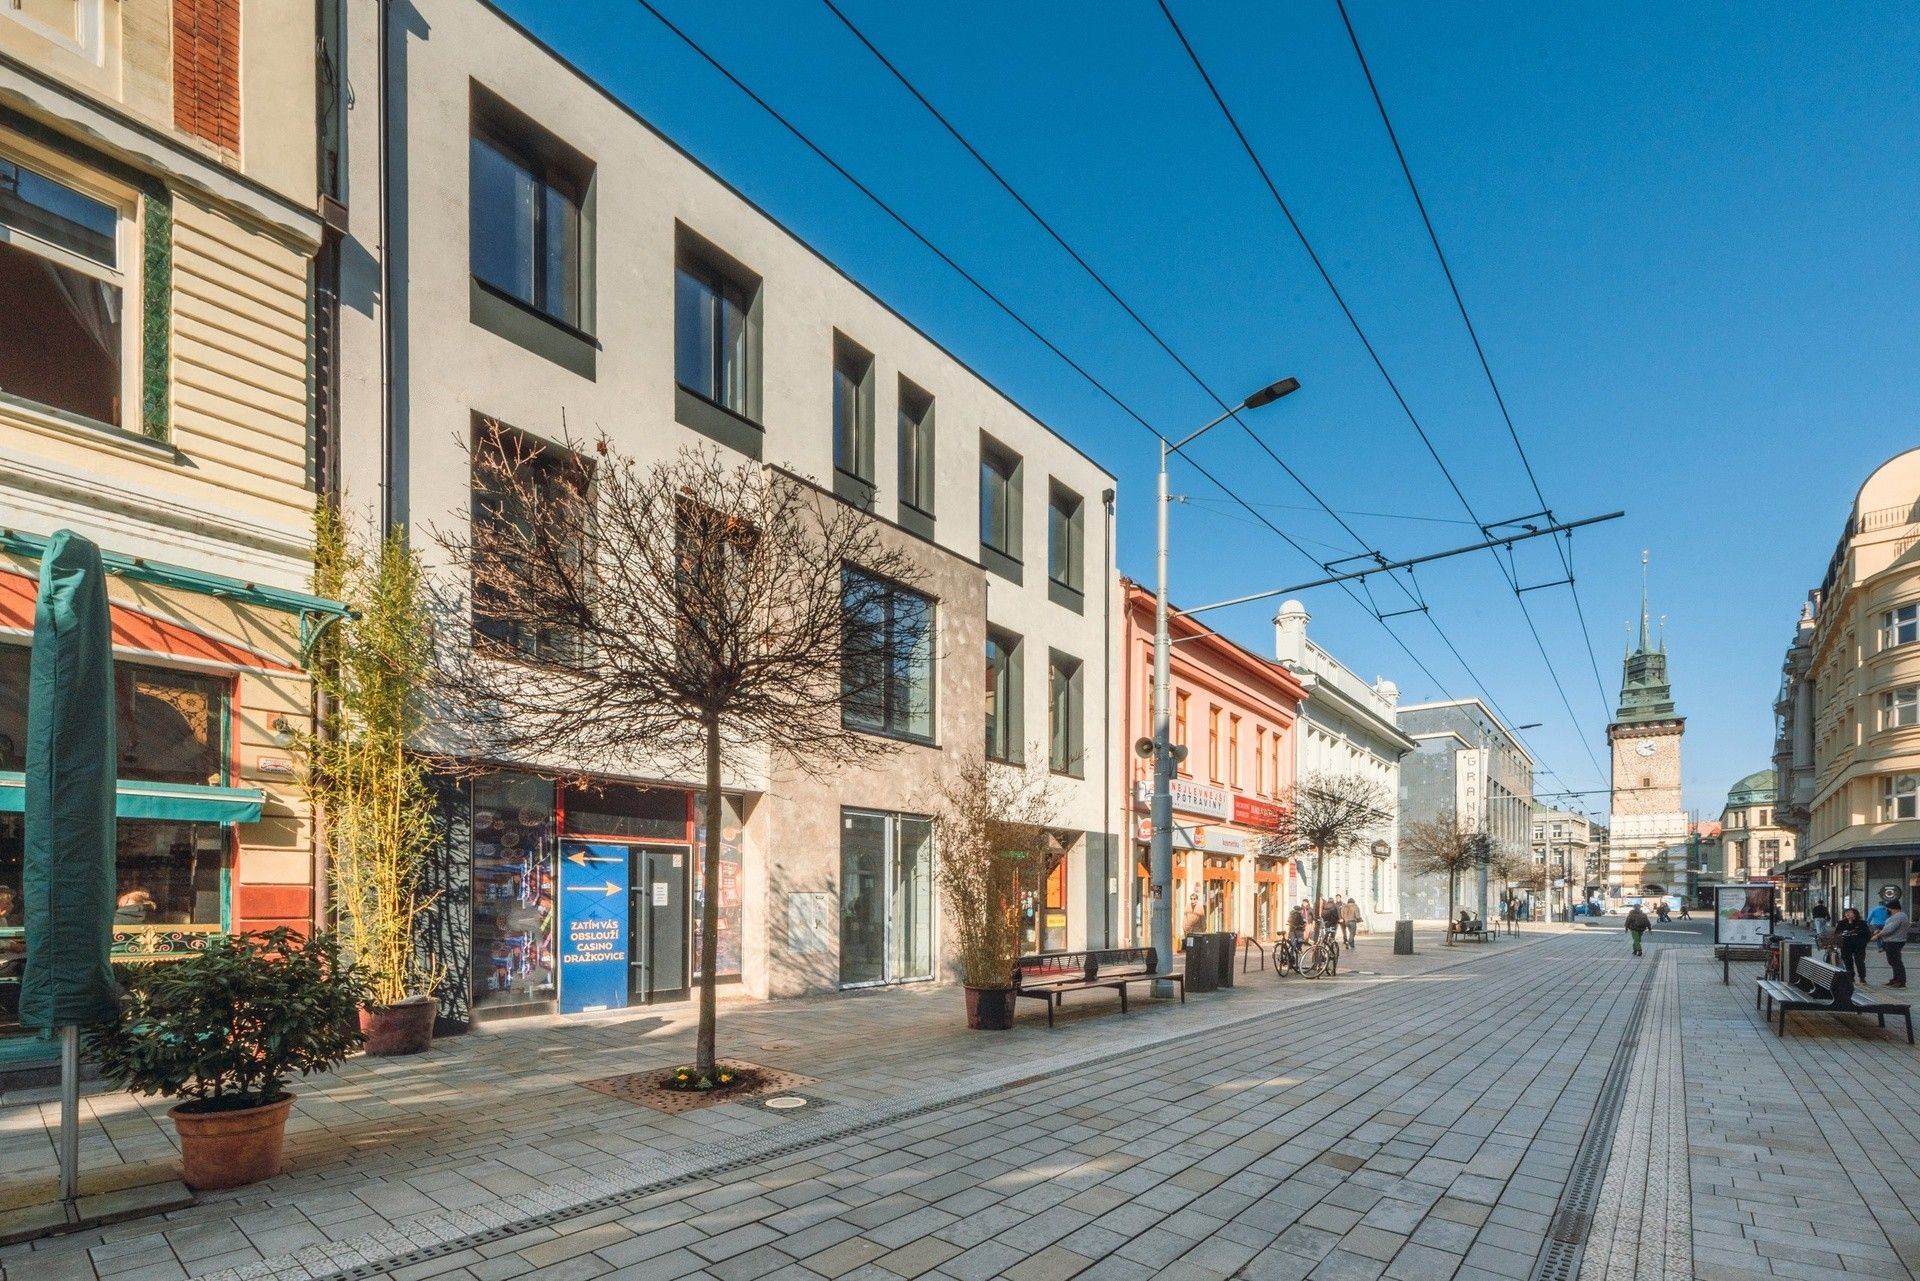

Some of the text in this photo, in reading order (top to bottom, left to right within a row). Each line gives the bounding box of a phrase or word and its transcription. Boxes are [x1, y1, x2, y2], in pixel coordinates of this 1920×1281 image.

[1466, 757, 1476, 826] GRAND
[1176, 792, 1221, 810] POTRAVINY
[571, 919, 619, 930] ZATÍM VÁS
[571, 929, 619, 941] OBSLOUŽÍ
[577, 942, 613, 951] CASINO
[564, 952, 625, 963] DRAŽKOVICE
